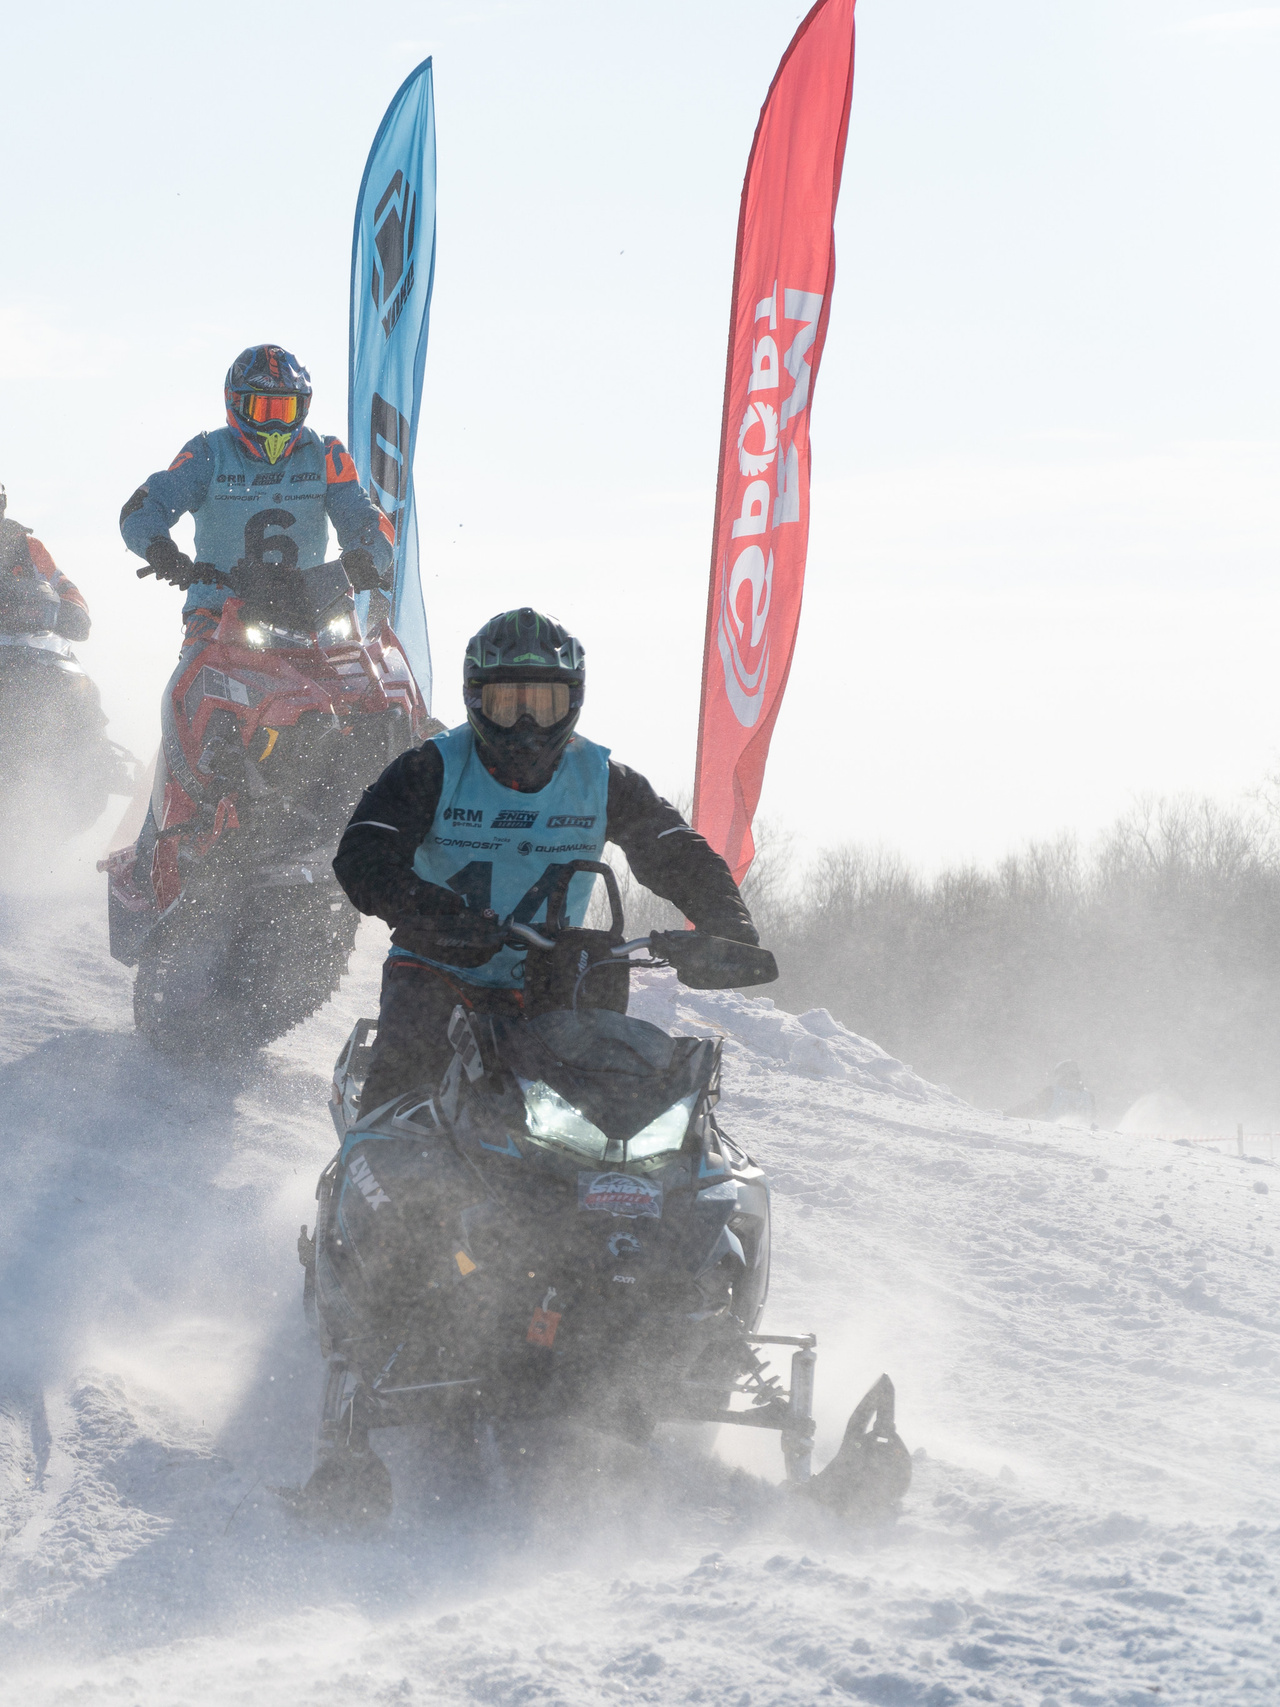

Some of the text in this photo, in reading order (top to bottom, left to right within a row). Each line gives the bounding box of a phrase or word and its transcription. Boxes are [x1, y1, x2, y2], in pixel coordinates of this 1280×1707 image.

[244, 508, 299, 571] 6
[434, 837, 502, 850] COMPOSIT
[445, 861, 570, 926] 14
[349, 1154, 391, 1211] LYNX
